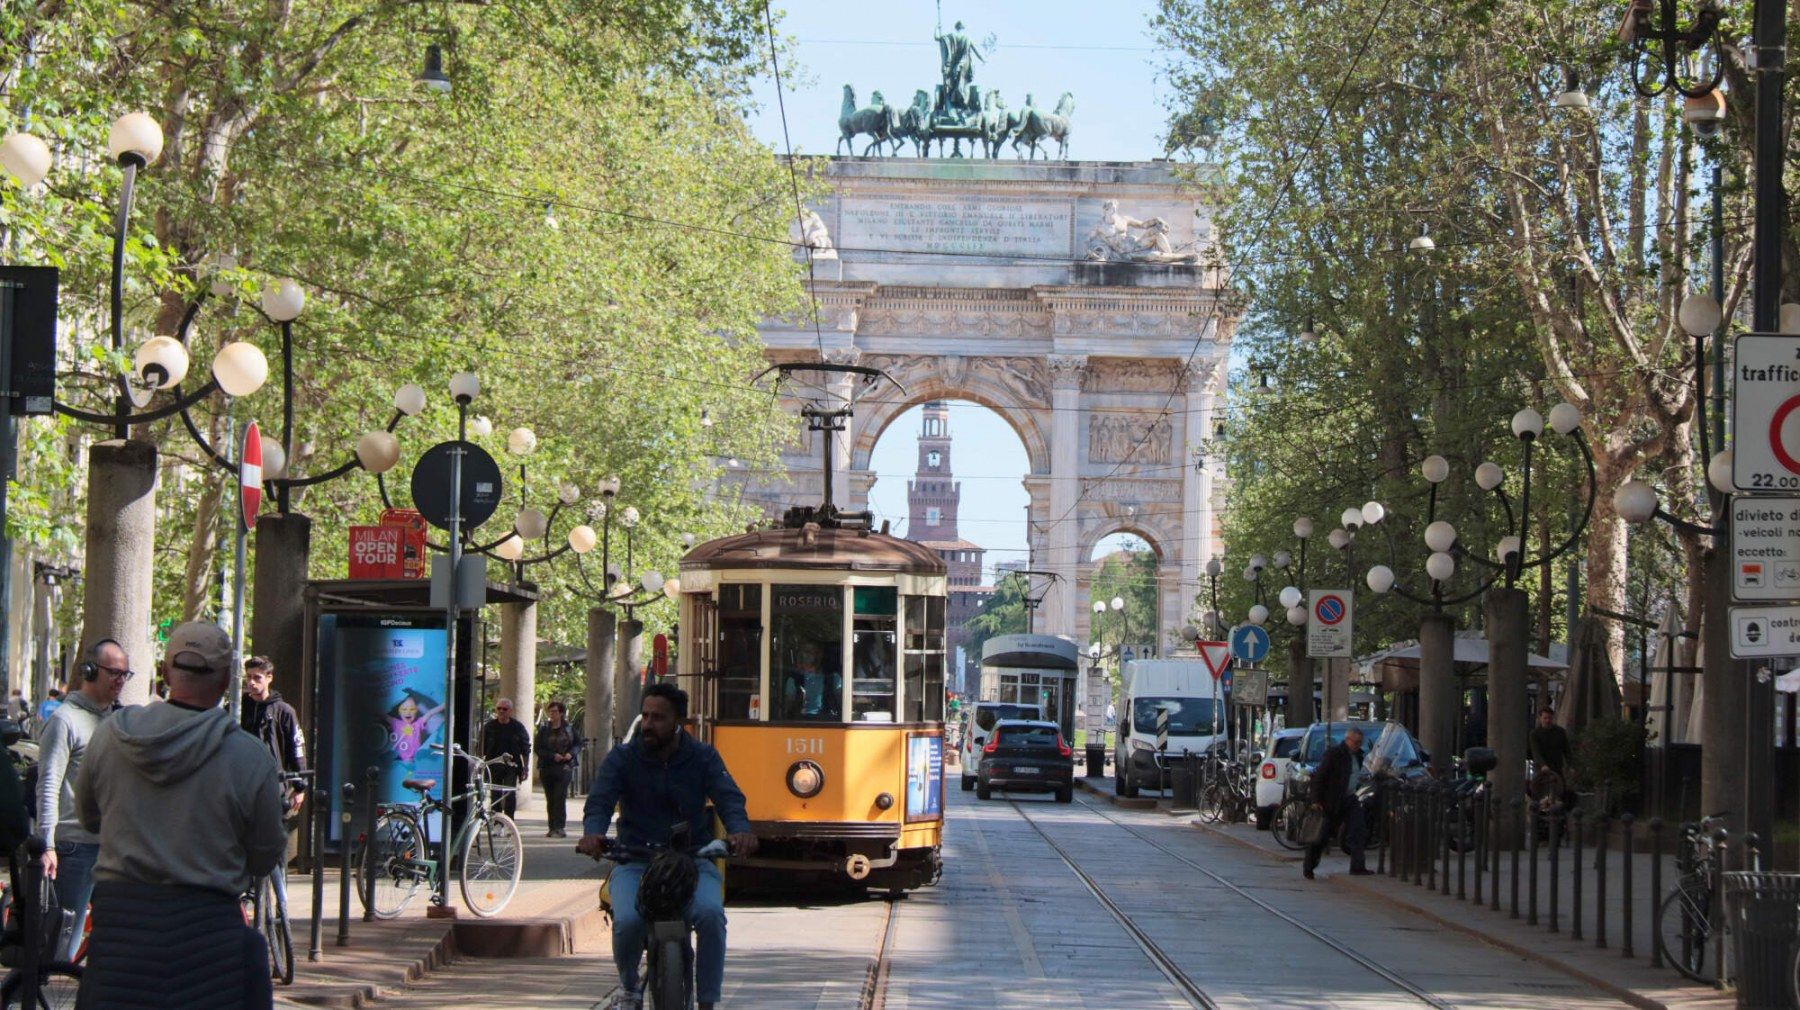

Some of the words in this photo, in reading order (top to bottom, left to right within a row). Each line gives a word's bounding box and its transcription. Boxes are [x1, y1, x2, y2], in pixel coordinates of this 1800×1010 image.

[1741, 364, 1800, 382] traffic
[1751, 473, 1798, 488] 22.00
[1735, 509, 1784, 521] divieto
[355, 530, 398, 542] MILAN
[355, 542, 398, 553] OPEN
[355, 553, 397, 565] TOUR
[779, 595, 837, 607] ROSERIO
[1770, 616, 1800, 628] contr
[785, 735, 825, 755] 1511
